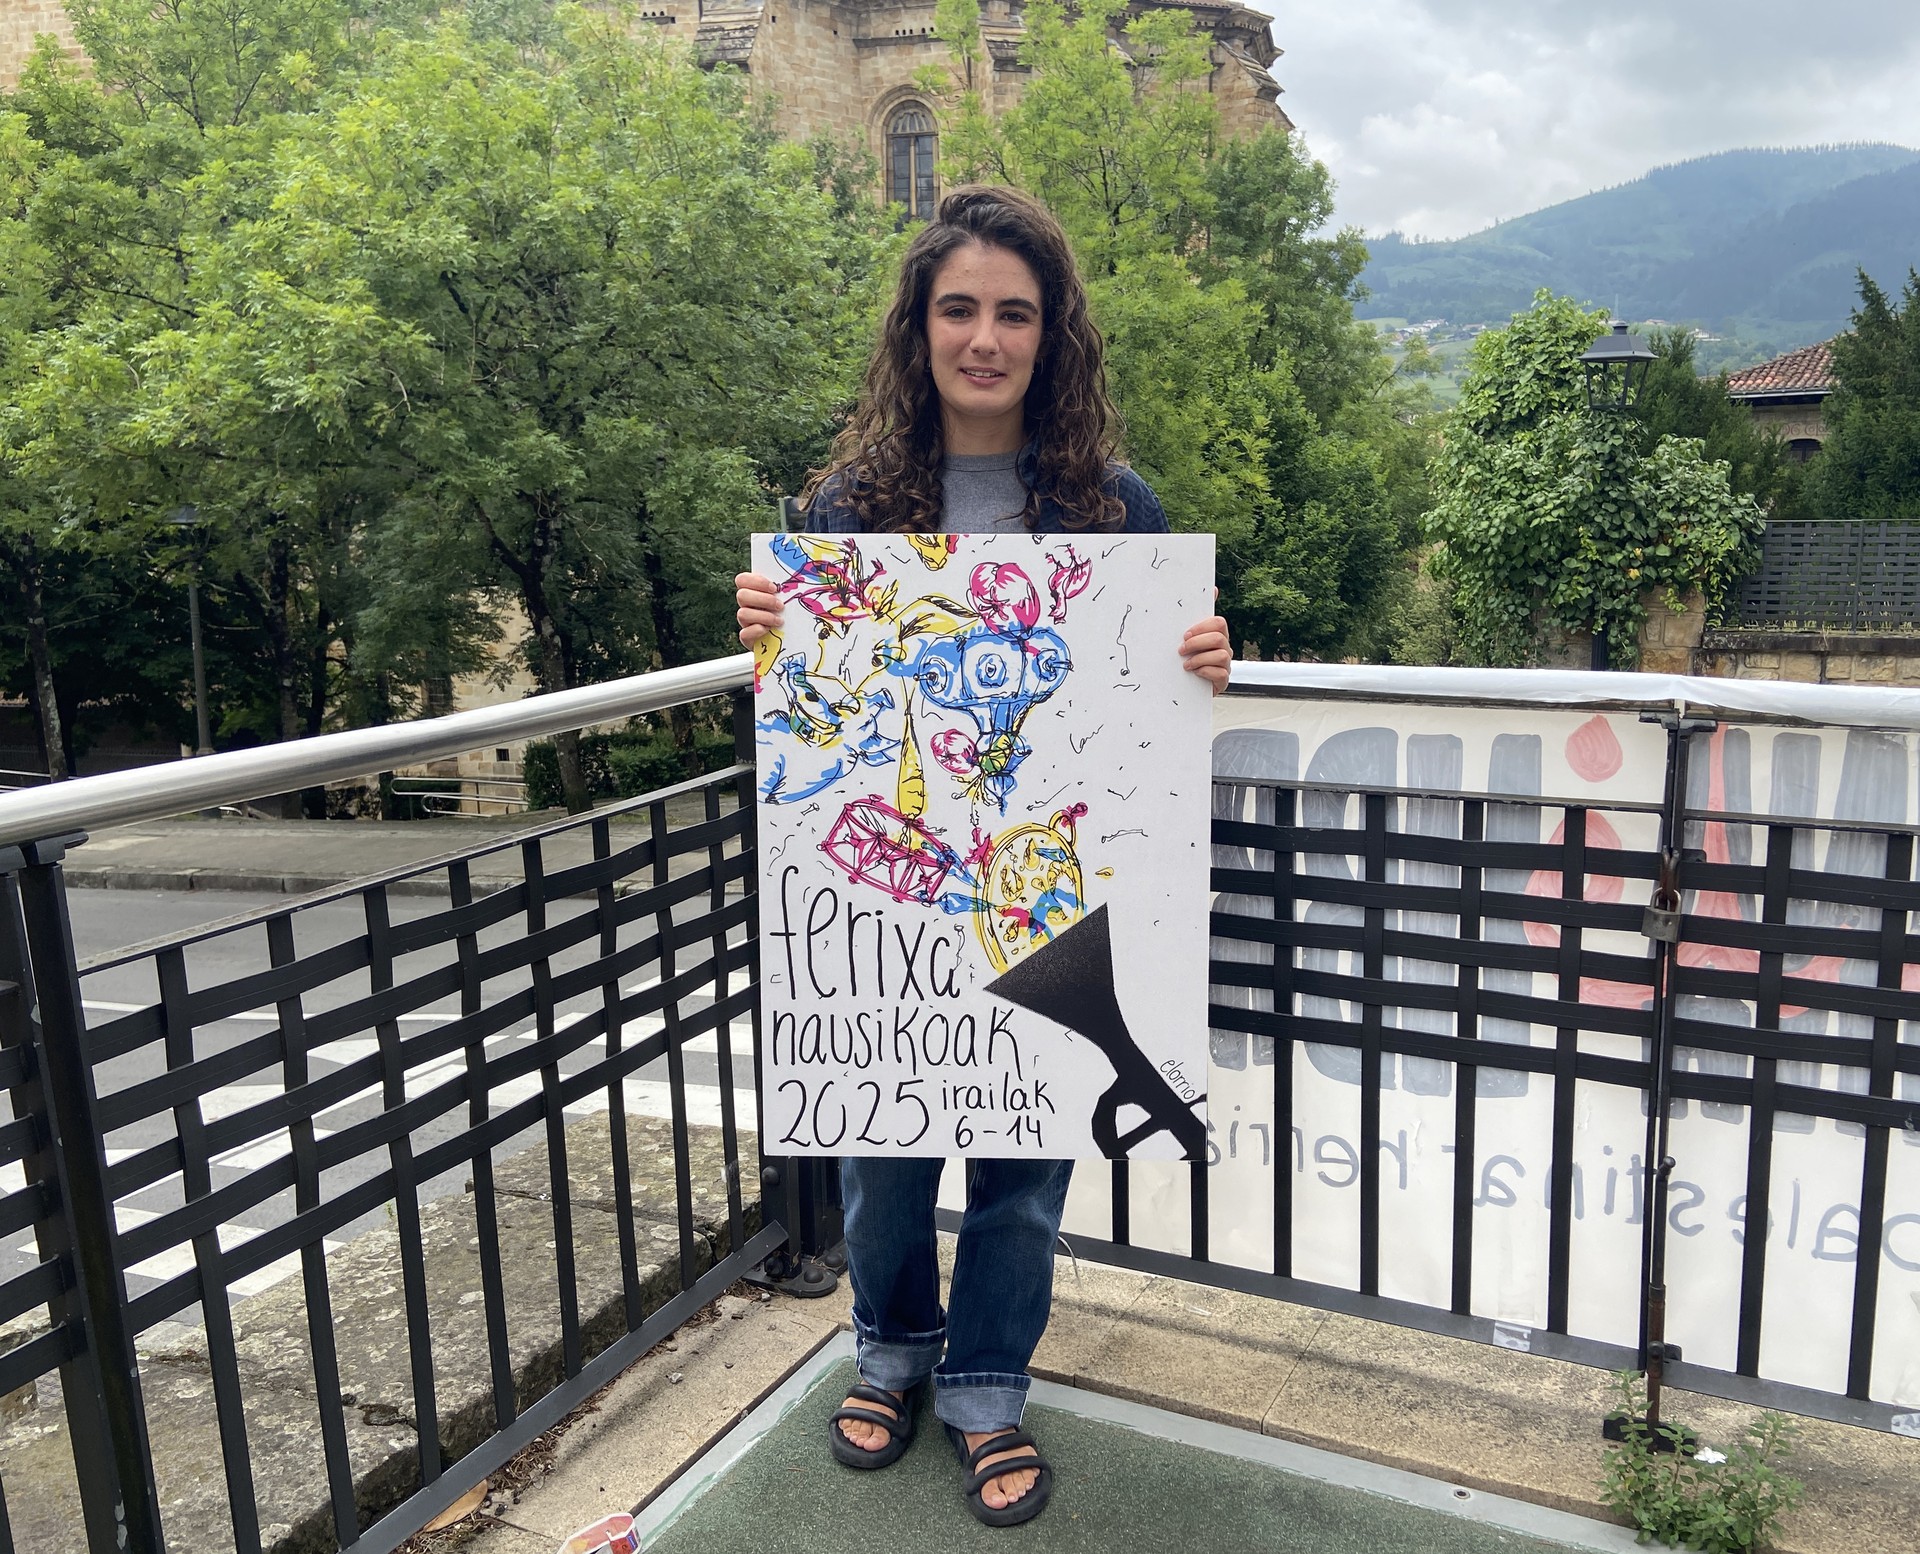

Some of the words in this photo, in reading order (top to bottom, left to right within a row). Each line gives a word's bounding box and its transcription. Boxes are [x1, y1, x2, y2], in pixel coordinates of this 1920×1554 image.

[769, 864, 961, 1000] ferixa
[772, 1006, 1023, 1080] nausikoak
[1159, 1059, 1196, 1100] elorrio
[777, 1078, 930, 1148] 2025
[942, 1072, 1055, 1114] irailak
